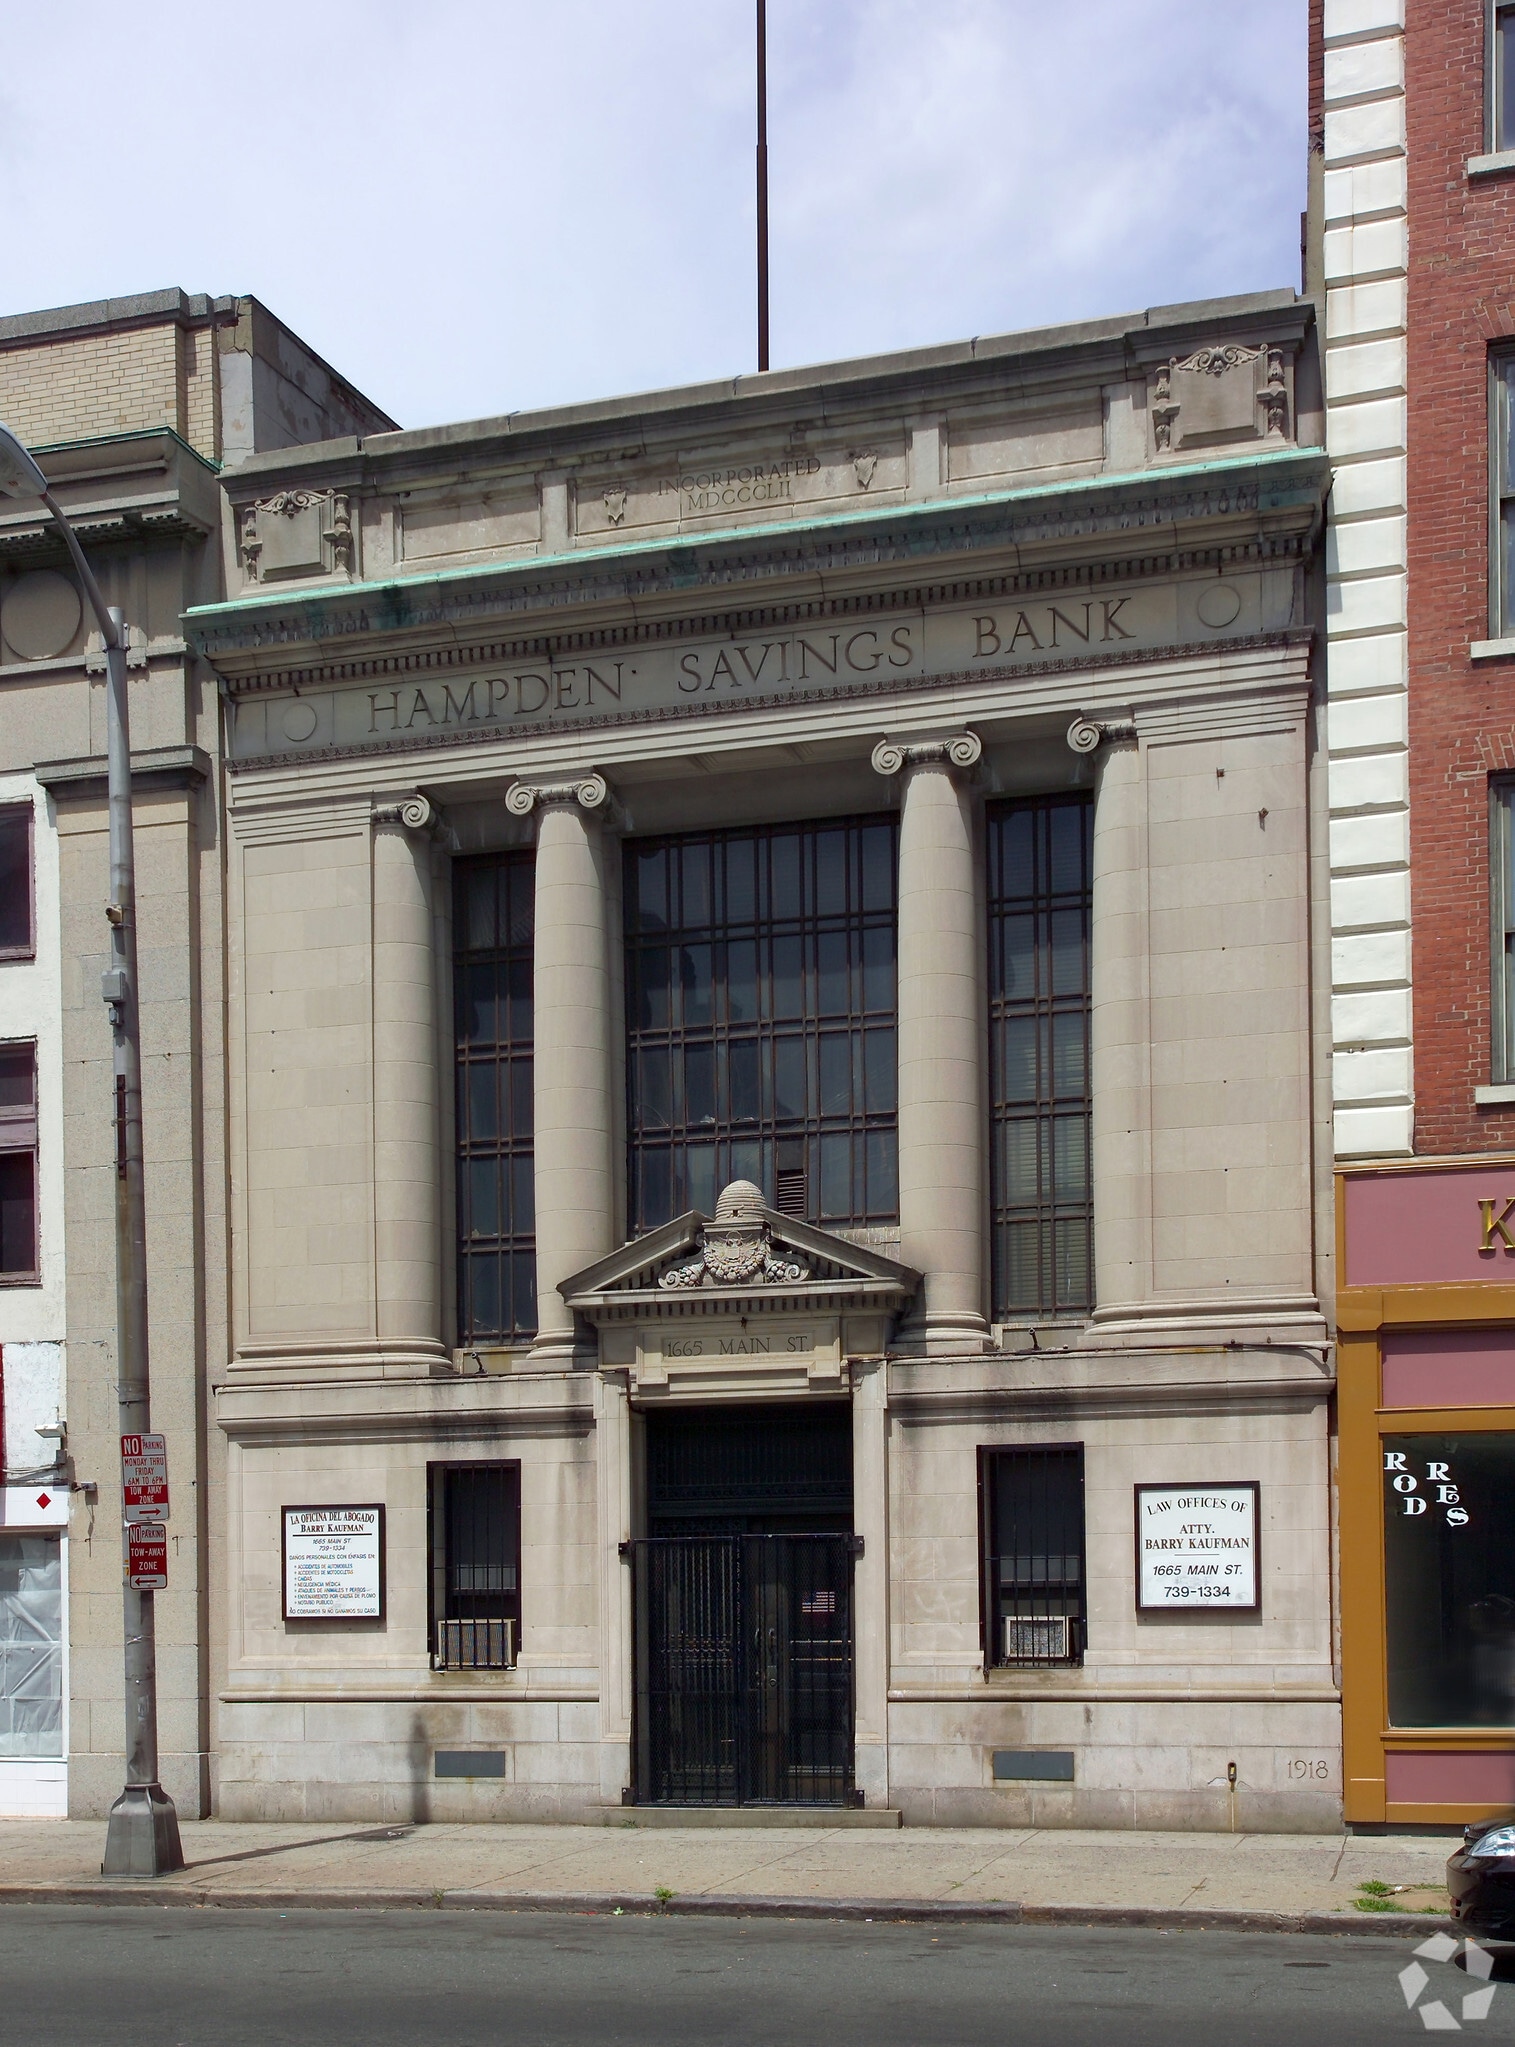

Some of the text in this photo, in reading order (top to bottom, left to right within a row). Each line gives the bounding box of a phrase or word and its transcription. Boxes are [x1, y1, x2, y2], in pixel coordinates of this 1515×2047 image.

[657, 457, 821, 496] INCORPORATED
[687, 481, 792, 511] MDCCCLII
[367, 597, 1136, 732] HAMPDEN SAVINGS BANK
[667, 1336, 810, 1357] 1665 MAIN ST.
[123, 1438, 163, 1455] NO PARKING
[124, 1456, 164, 1466] MONDAY THRU
[135, 1467, 155, 1475] FRIDAY
[127, 1475, 164, 1485] 6AM TO 6PM
[129, 1485, 162, 1495] TOW AWAY
[139, 1495, 155, 1504] ZONE
[1147, 1497, 1248, 1515] LAW OFFICES OF
[290, 1511, 375, 1525] LA OFICINA DEL ABOGADO
[301, 1523, 364, 1533] BARRY KAUFMAN
[1179, 1524, 1215, 1534] ATTY.
[130, 1526, 164, 1543] NO PARKING
[1145, 1537, 1250, 1550] BARRY KAUFMAN
[130, 1548, 165, 1556] TOW-AWAY
[138, 1561, 158, 1570] ZONE
[1153, 1564, 1243, 1575] 1665 MAIN ST.
[1164, 1585, 1231, 1597] 739-1334
[1287, 1760, 1329, 1779] 1918
